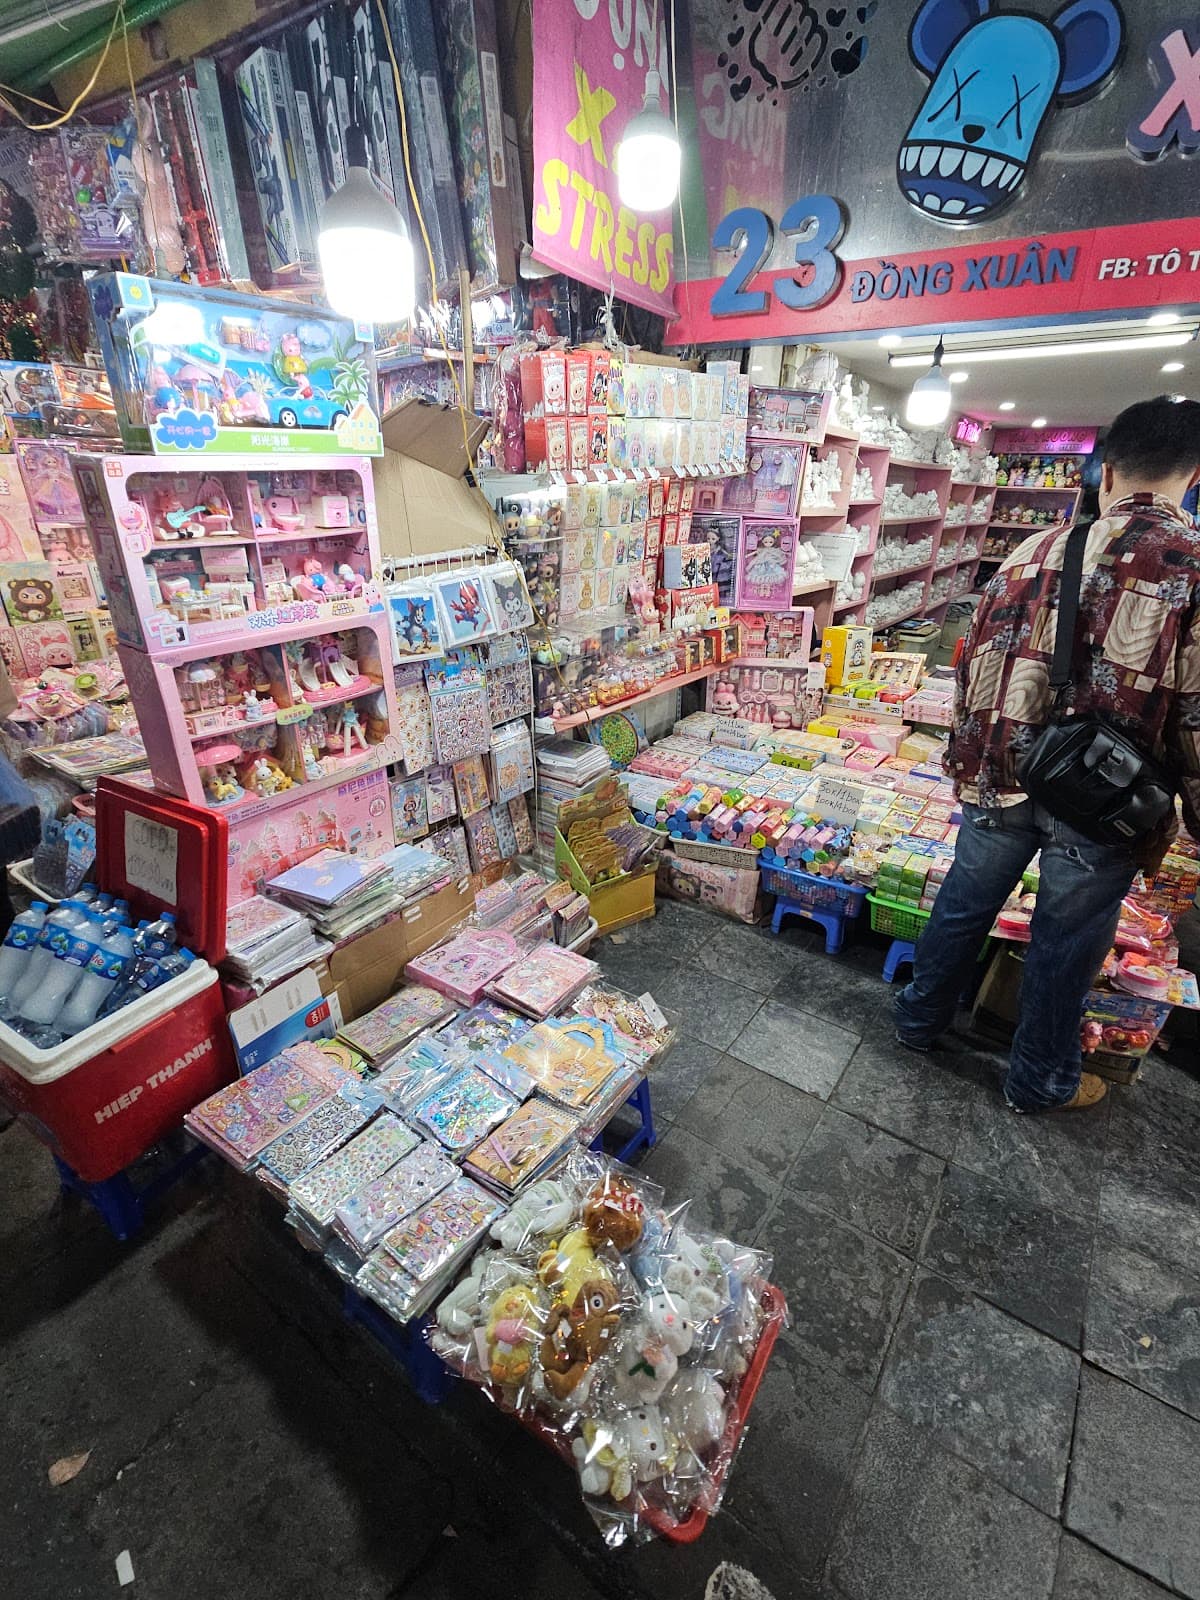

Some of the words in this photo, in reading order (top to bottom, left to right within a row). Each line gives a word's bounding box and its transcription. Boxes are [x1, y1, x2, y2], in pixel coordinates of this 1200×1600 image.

[536, 158, 673, 293] STRESS
[712, 195, 843, 316] 23
[1098, 257, 1137, 281] FB:
[1146, 247, 1182, 276] TÔ
[851, 260, 952, 303] ĐỒNG
[961, 242, 1079, 292] XUÂN
